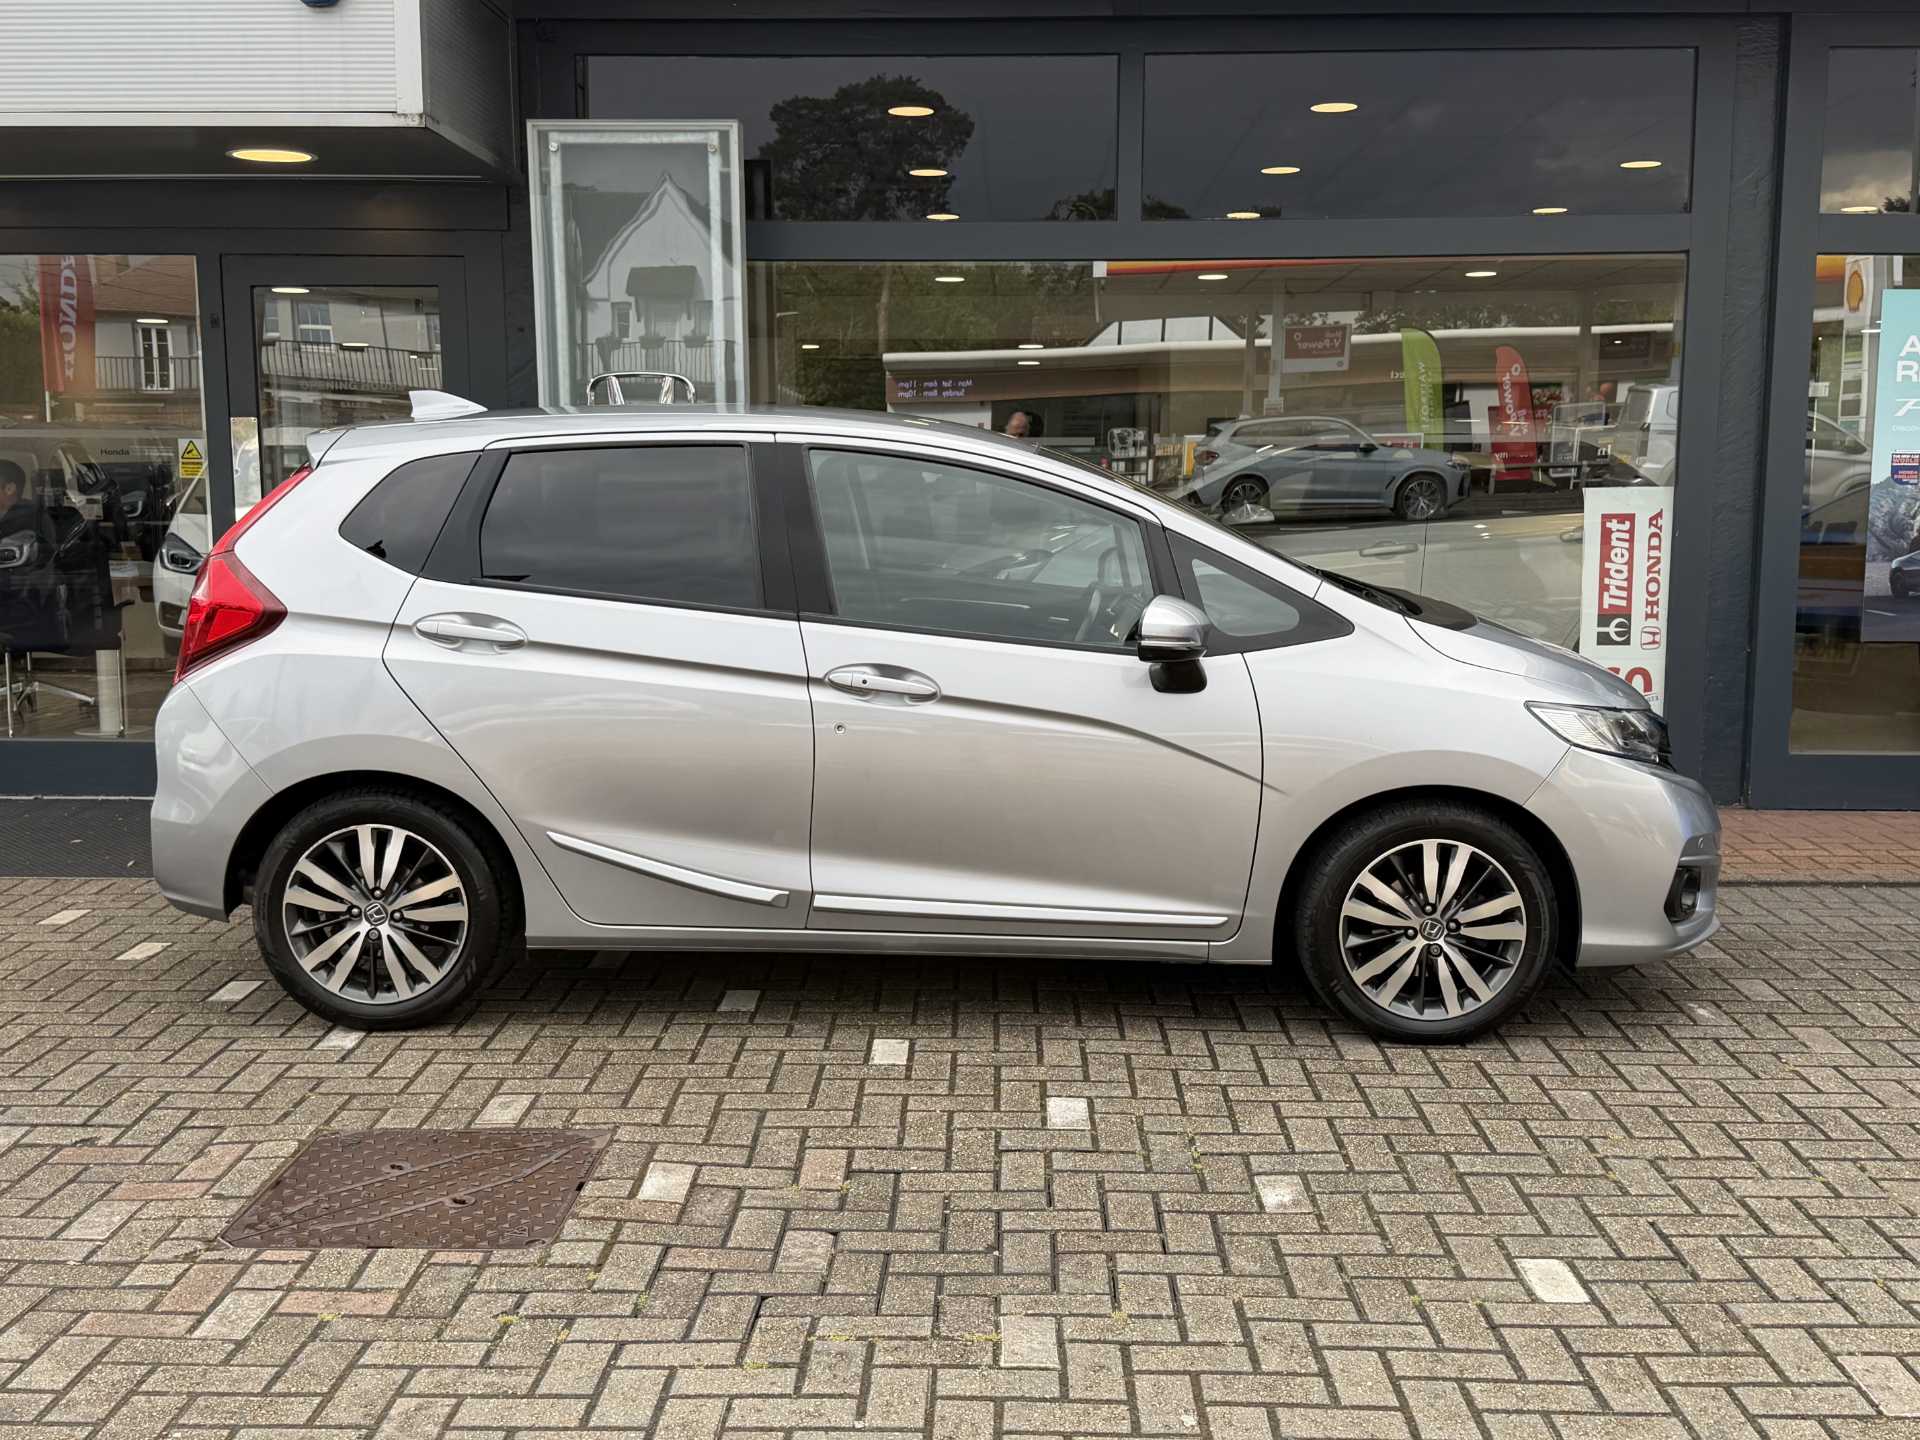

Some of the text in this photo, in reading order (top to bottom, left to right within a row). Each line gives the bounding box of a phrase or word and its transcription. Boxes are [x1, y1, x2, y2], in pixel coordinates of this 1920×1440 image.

[1896, 360, 1920, 382] R
[101, 448, 130, 456] Honda
[1603, 518, 1631, 609] Trident
[1644, 508, 1663, 621] HONDA
